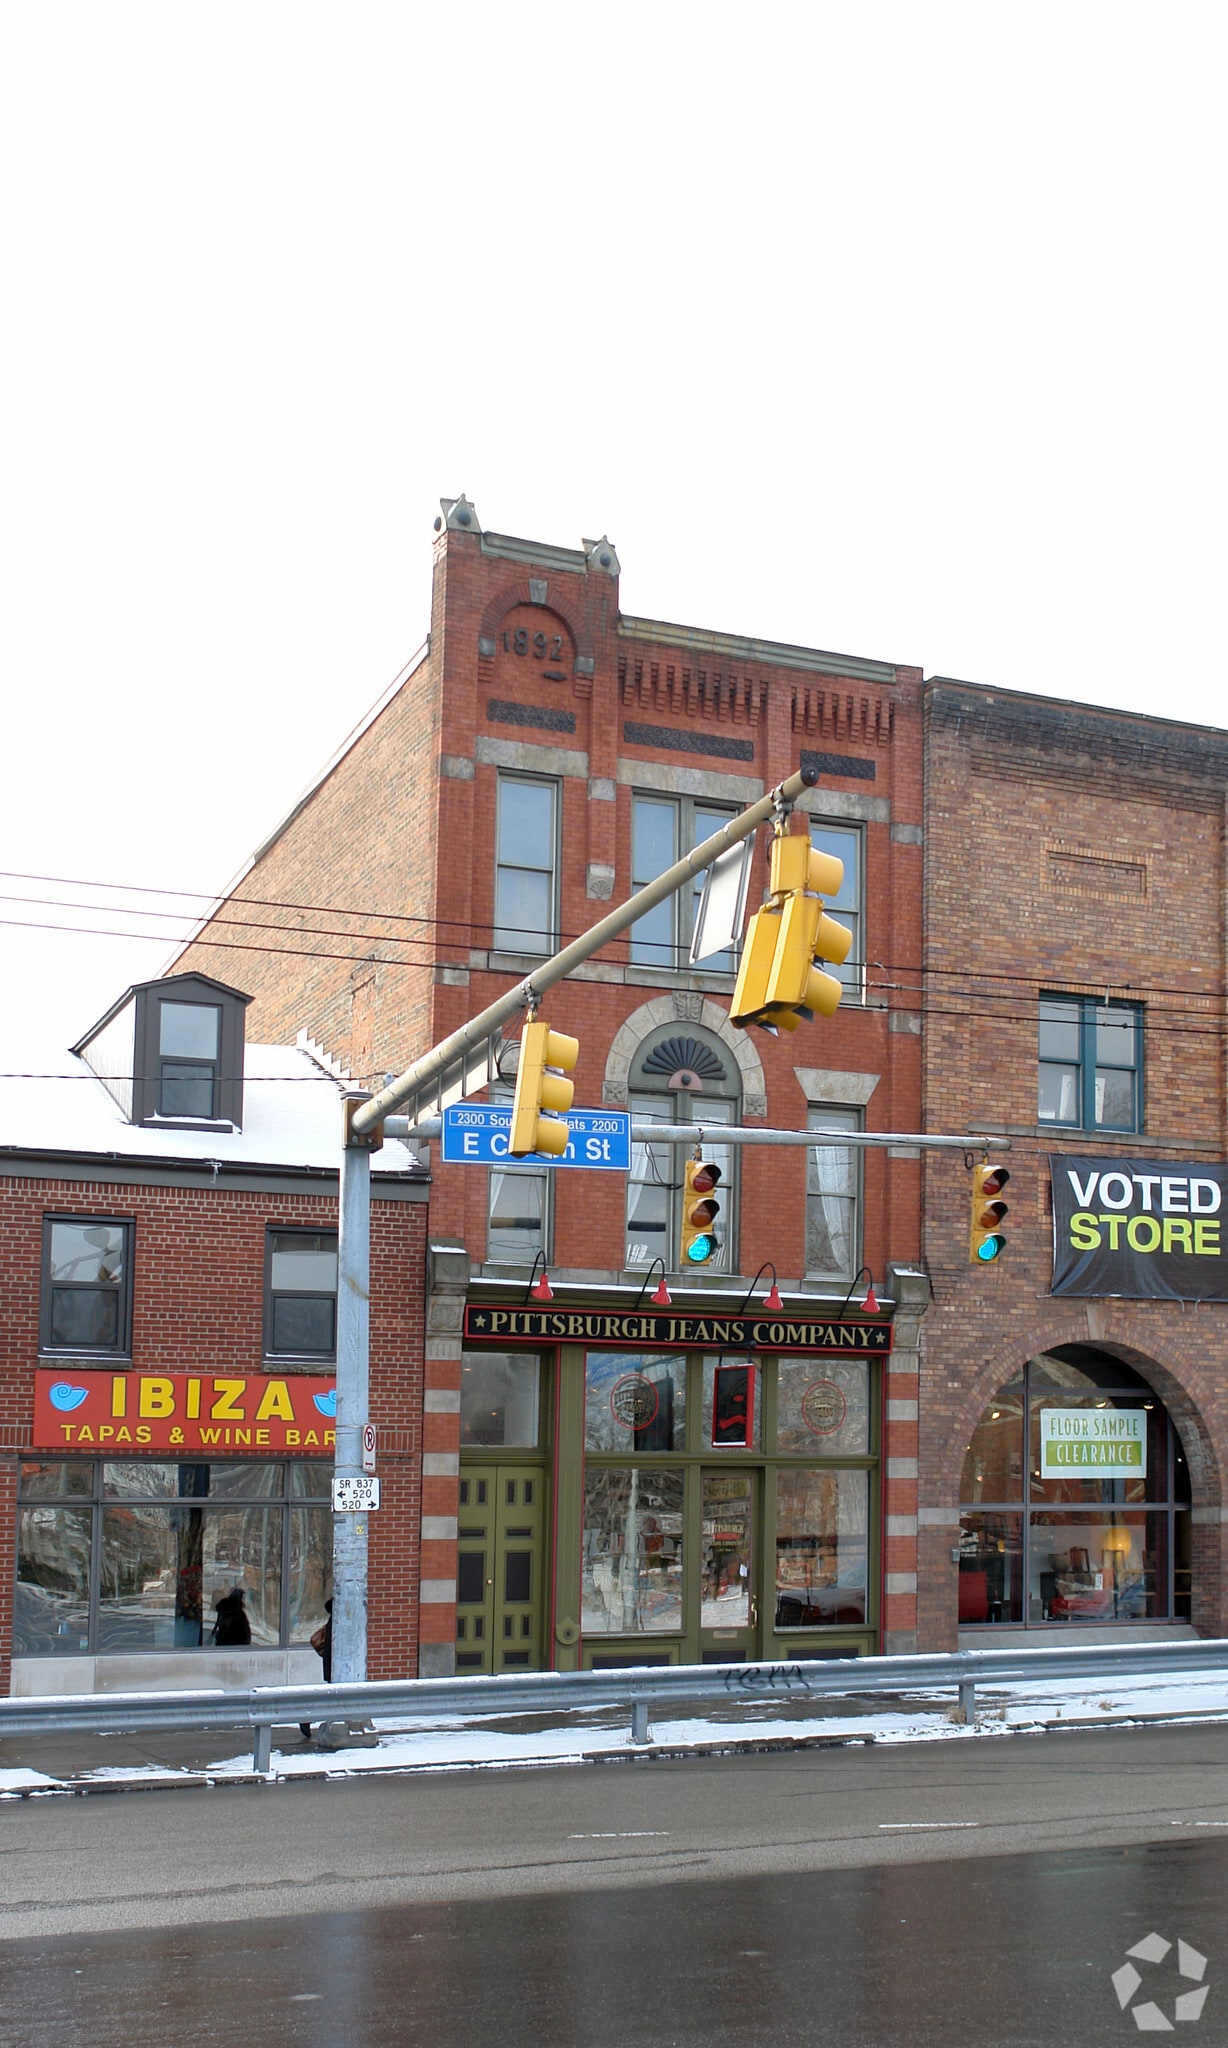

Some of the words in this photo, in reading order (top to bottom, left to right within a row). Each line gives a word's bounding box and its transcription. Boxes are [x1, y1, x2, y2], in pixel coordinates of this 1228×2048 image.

[503, 627, 563, 661] 1892
[457, 1113, 485, 1125] 2300
[490, 1114, 512, 1126] Sou
[592, 1120, 618, 1132] 2200
[463, 1132, 480, 1155] E
[586, 1137, 611, 1161] St
[1067, 1170, 1222, 1214] VOTED
[1069, 1212, 1221, 1255] STORE
[490, 1311, 657, 1339] PITTSBURGH
[665, 1319, 745, 1343] JEANS
[752, 1322, 874, 1348] COMPANY
[111, 1376, 296, 1421] IBIZA
[60, 1424, 152, 1443] TAPAS
[168, 1427, 185, 1444] &
[199, 1427, 271, 1445] WINE
[285, 1429, 336, 1446] BAR
[1050, 1417, 1089, 1436] FLOOR
[1094, 1418, 1138, 1436] SAMPLE
[1056, 1444, 1132, 1463] CLEARANCE
[339, 1479, 351, 1488] SR
[356, 1479, 374, 1488] 837
[353, 1488, 372, 1498] 520
[342, 1500, 361, 1509] 520
